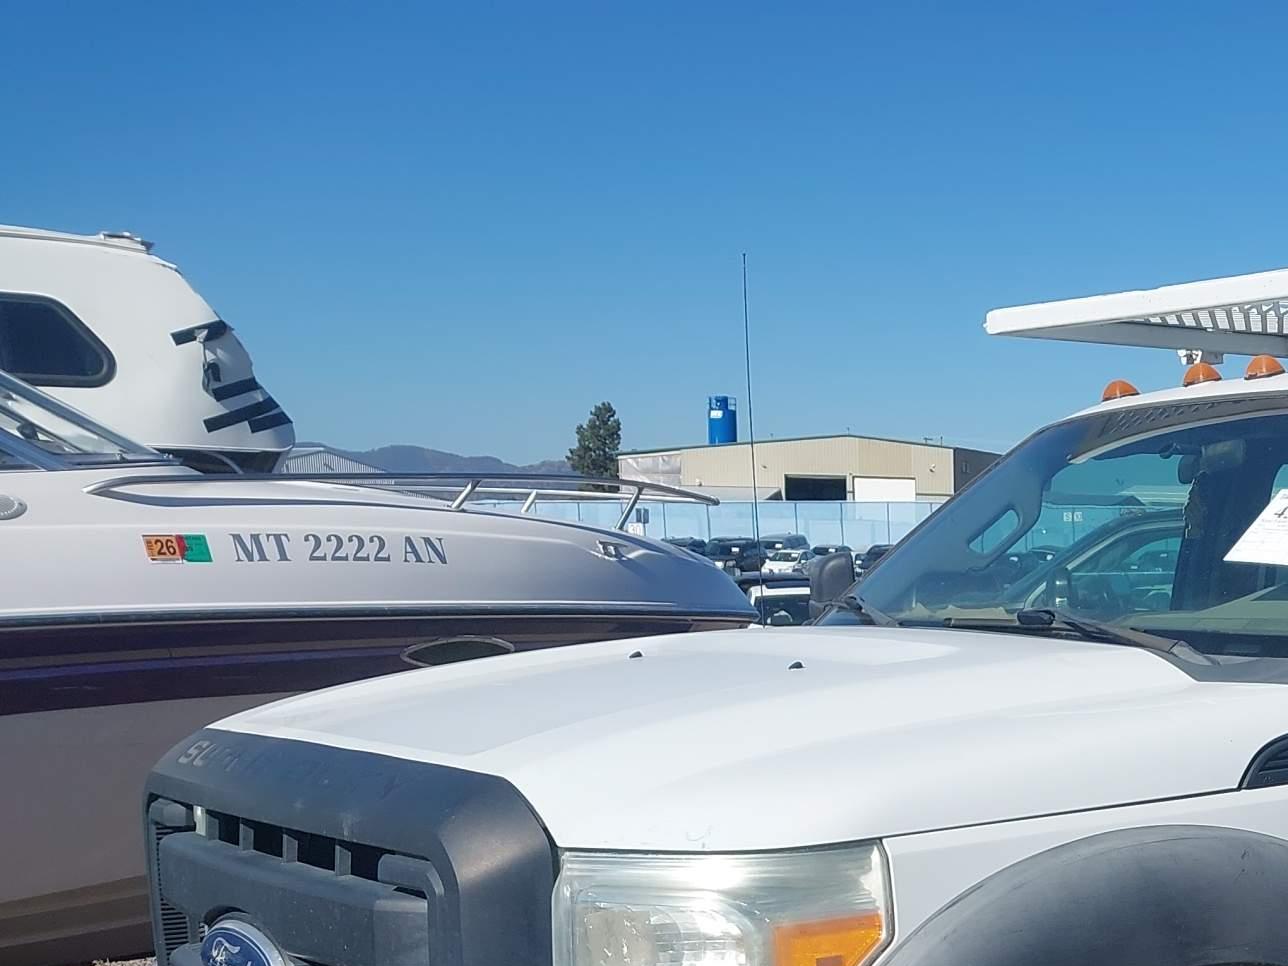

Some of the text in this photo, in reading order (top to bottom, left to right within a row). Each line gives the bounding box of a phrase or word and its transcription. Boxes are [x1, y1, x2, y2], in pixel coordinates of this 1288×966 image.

[154, 539, 177, 556] 26
[228, 533, 292, 562] MT
[303, 533, 391, 562] 2222
[403, 535, 448, 564] AN
